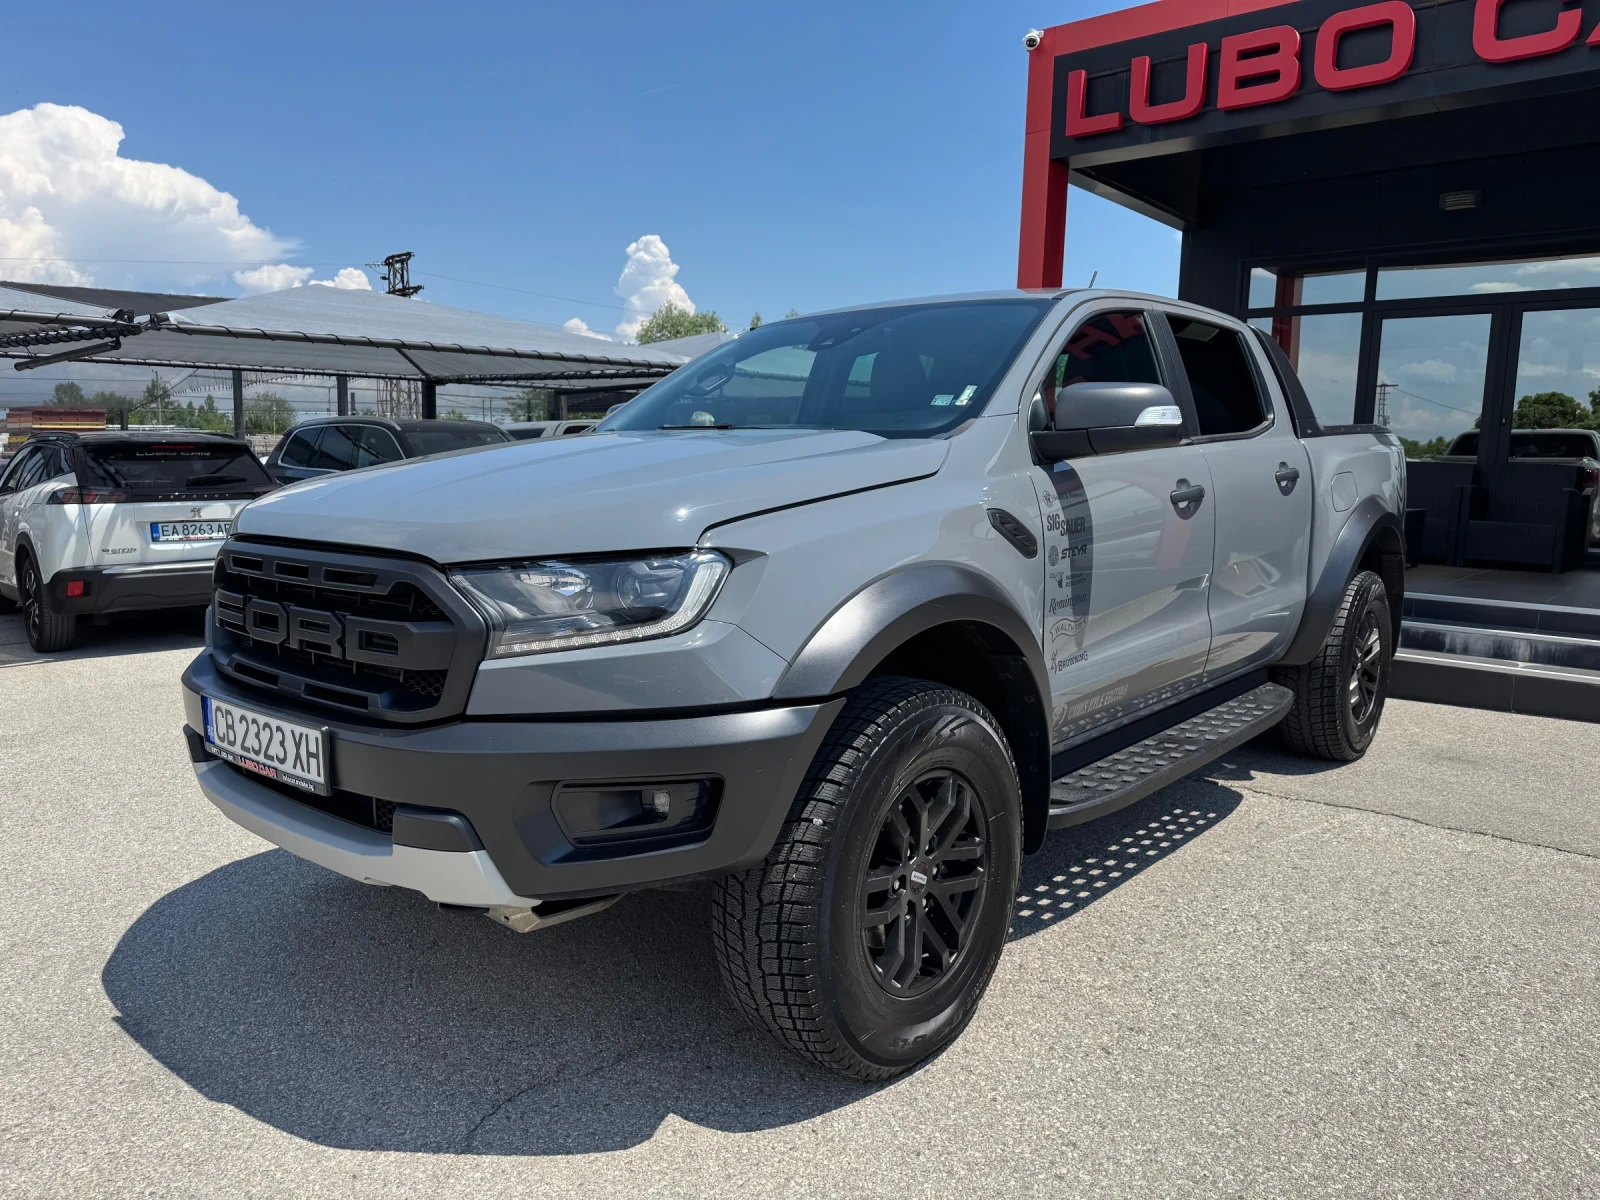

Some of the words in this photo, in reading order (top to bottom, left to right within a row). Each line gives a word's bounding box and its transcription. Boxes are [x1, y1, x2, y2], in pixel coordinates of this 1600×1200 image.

[1065, 0, 1416, 138] LUBO
[1472, 0, 1600, 63] C
[161, 524, 179, 537] EA
[182, 523, 213, 536] 8263
[1046, 513, 1060, 532] SIG
[1060, 516, 1086, 536] SAUER
[1060, 544, 1087, 560] STEYR
[1065, 572, 1084, 581] MAGNUM
[1065, 577, 1087, 587] RESEARCH
[1048, 593, 1087, 614] Remington
[214, 587, 456, 671] FORD
[1054, 621, 1083, 635] WALTHER
[1058, 650, 1088, 672] BROWNING
[214, 705, 237, 748] CB
[239, 713, 288, 765] 2323
[290, 729, 322, 778] XH
[259, 764, 278, 779] CAR
